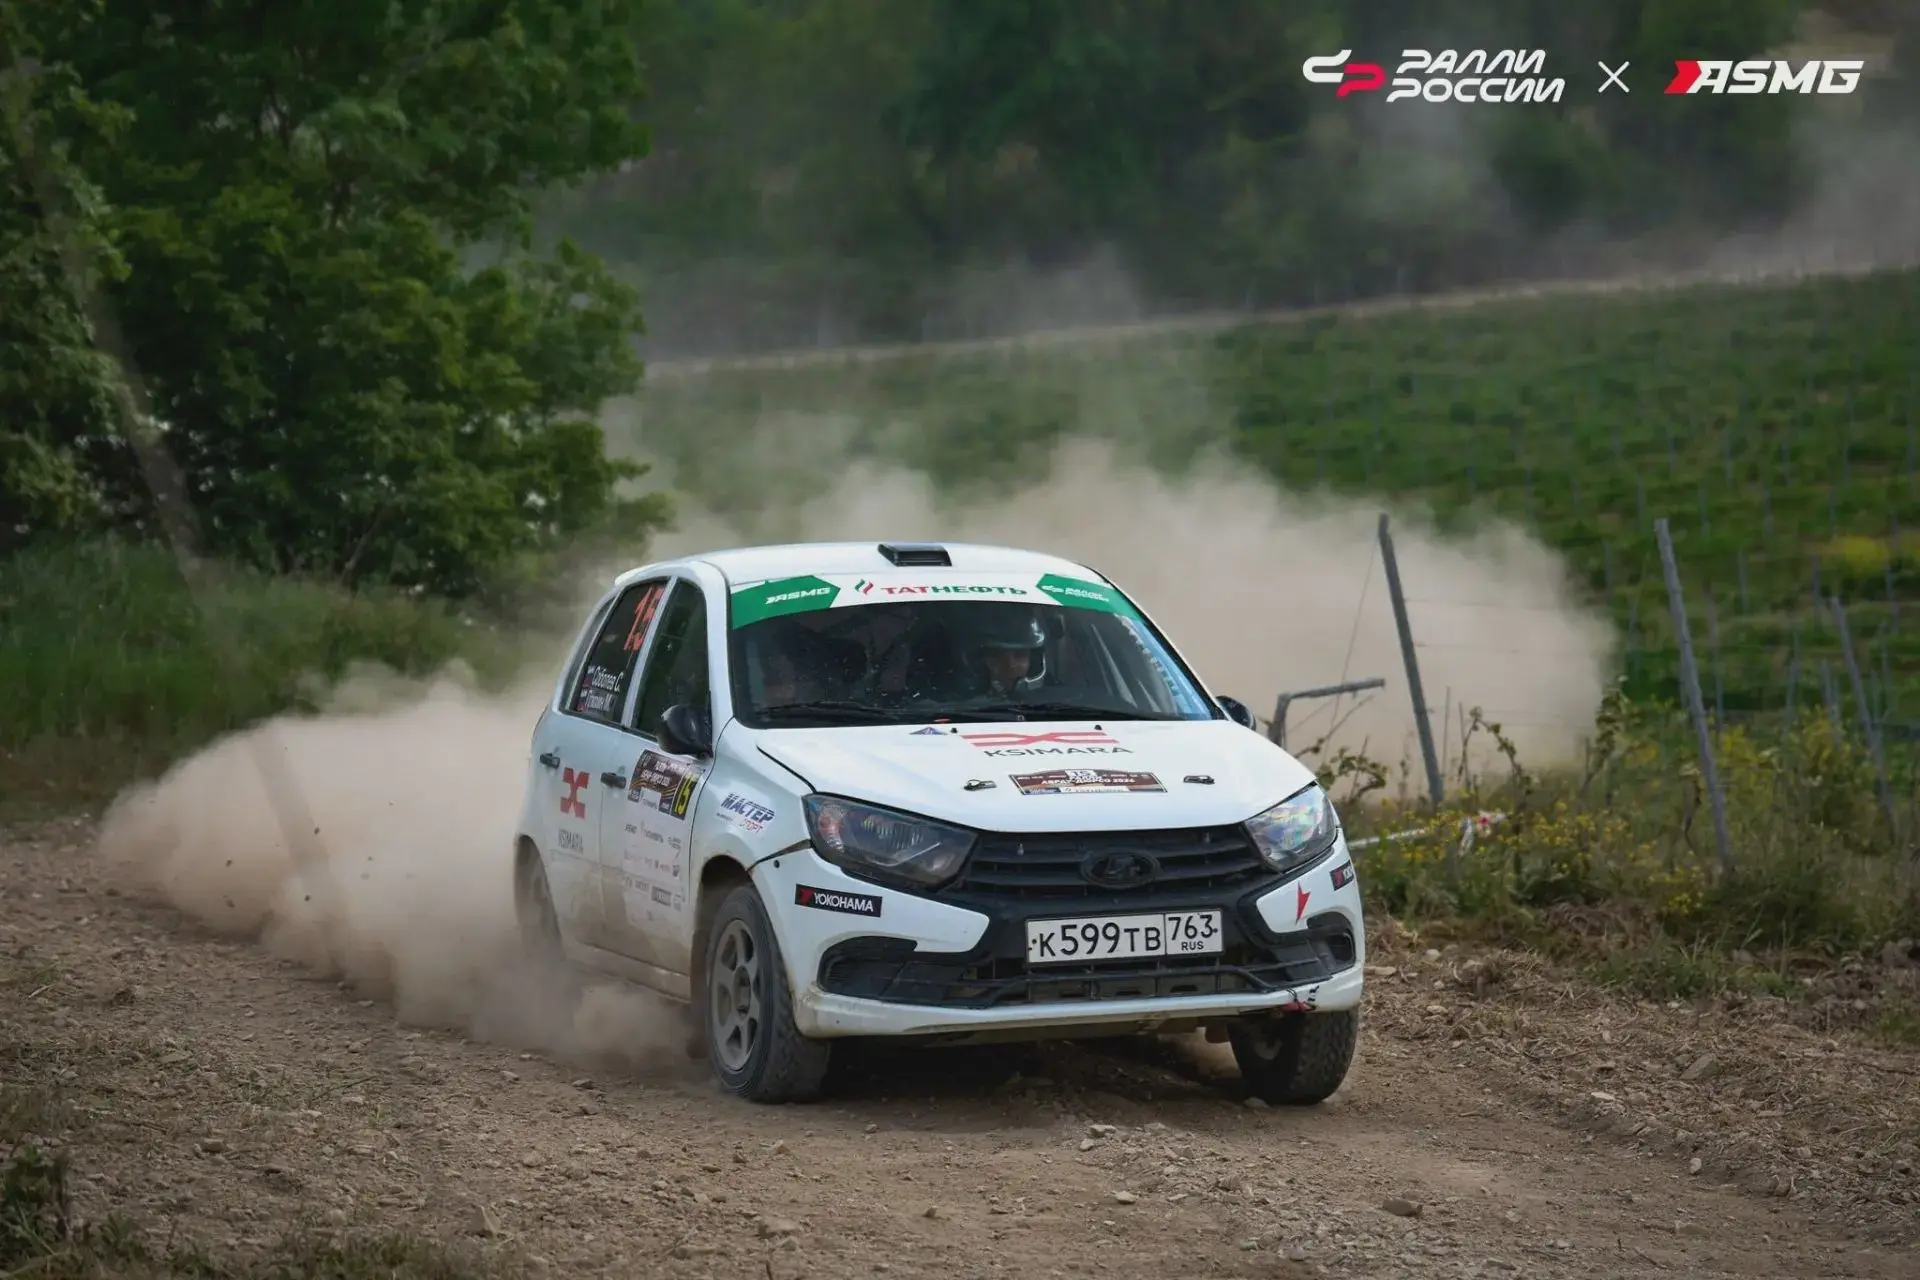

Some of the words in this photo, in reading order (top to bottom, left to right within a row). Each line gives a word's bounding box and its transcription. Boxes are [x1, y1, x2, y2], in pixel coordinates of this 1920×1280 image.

[774, 587, 831, 602] ASMG
[880, 584, 1028, 597] ТАТНЕФТЬ
[984, 747, 1135, 758] KSIMARA
[721, 792, 776, 823] МАСТЕР
[813, 891, 874, 913] YOKOHAMA
[1038, 922, 1162, 957] К599ТВ
[1167, 914, 1214, 941] 763
[1181, 941, 1205, 951] RUS
